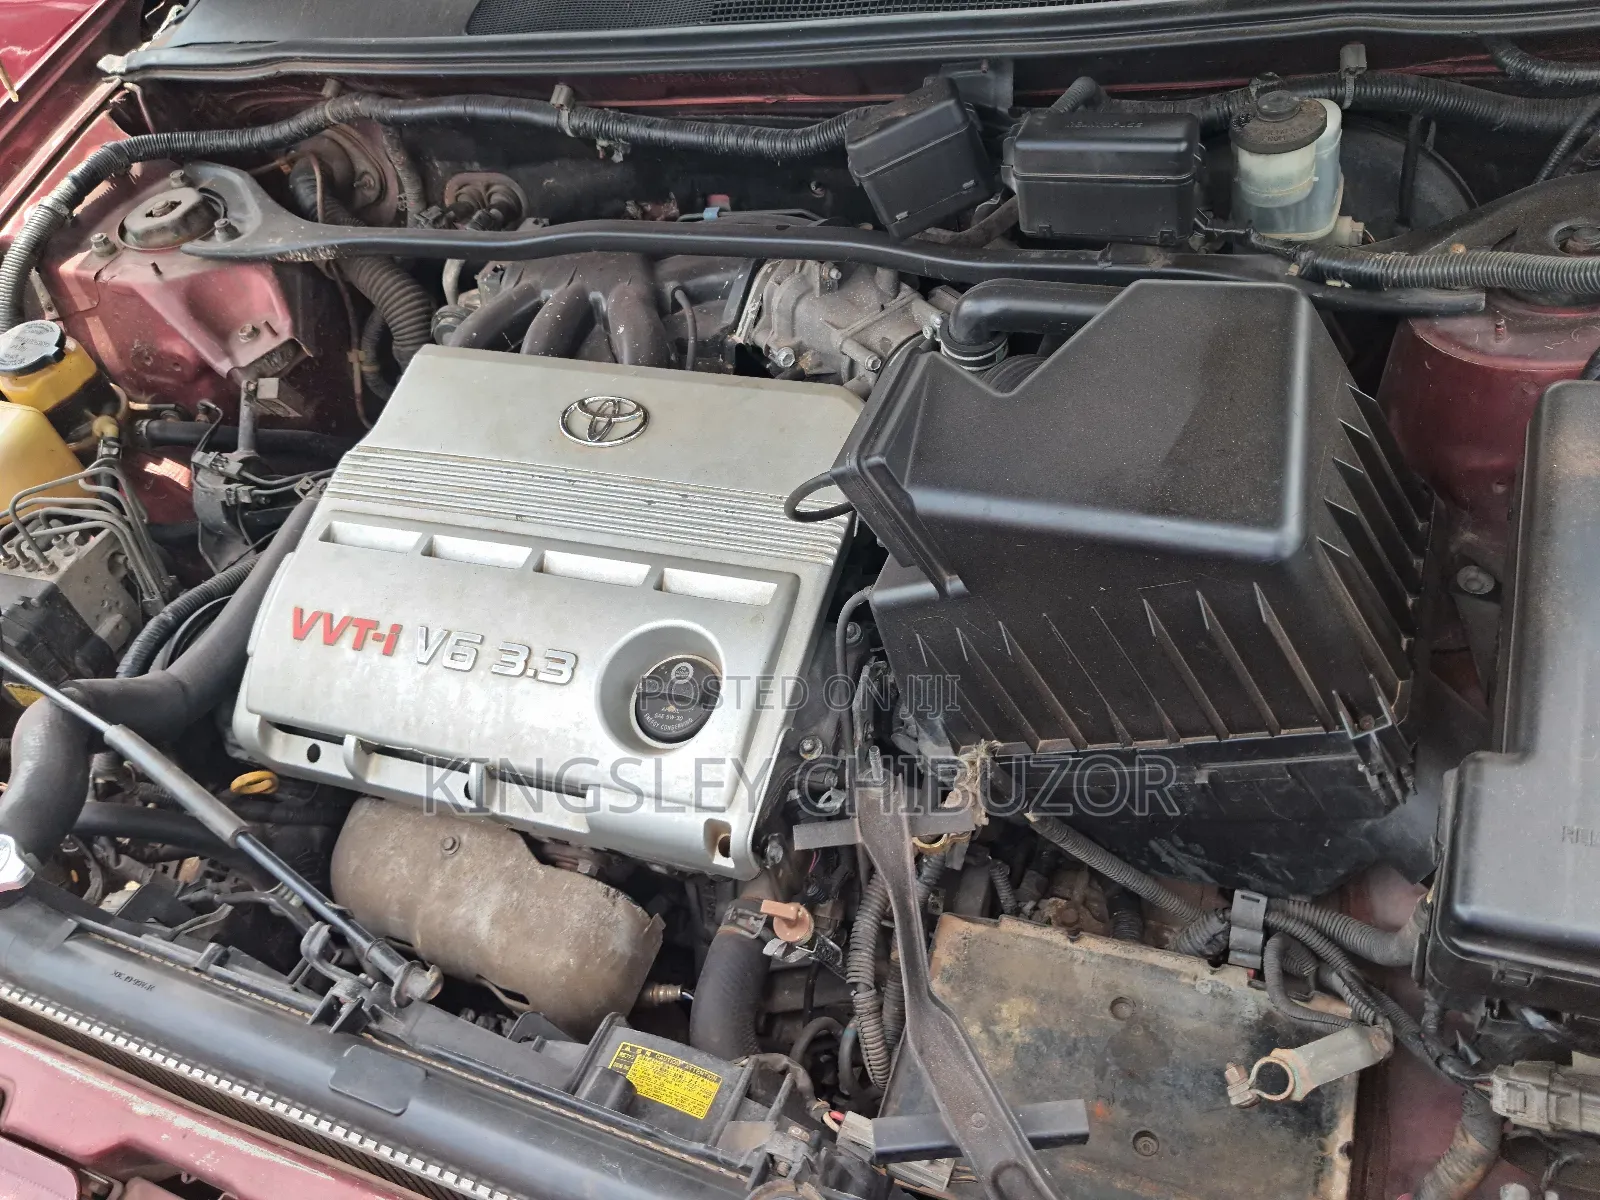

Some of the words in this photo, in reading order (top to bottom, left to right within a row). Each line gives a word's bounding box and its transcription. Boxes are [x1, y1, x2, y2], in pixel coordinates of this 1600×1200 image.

[292, 606, 404, 656] VVT-i
[417, 625, 485, 672] V6
[491, 641, 579, 686] 3.3
